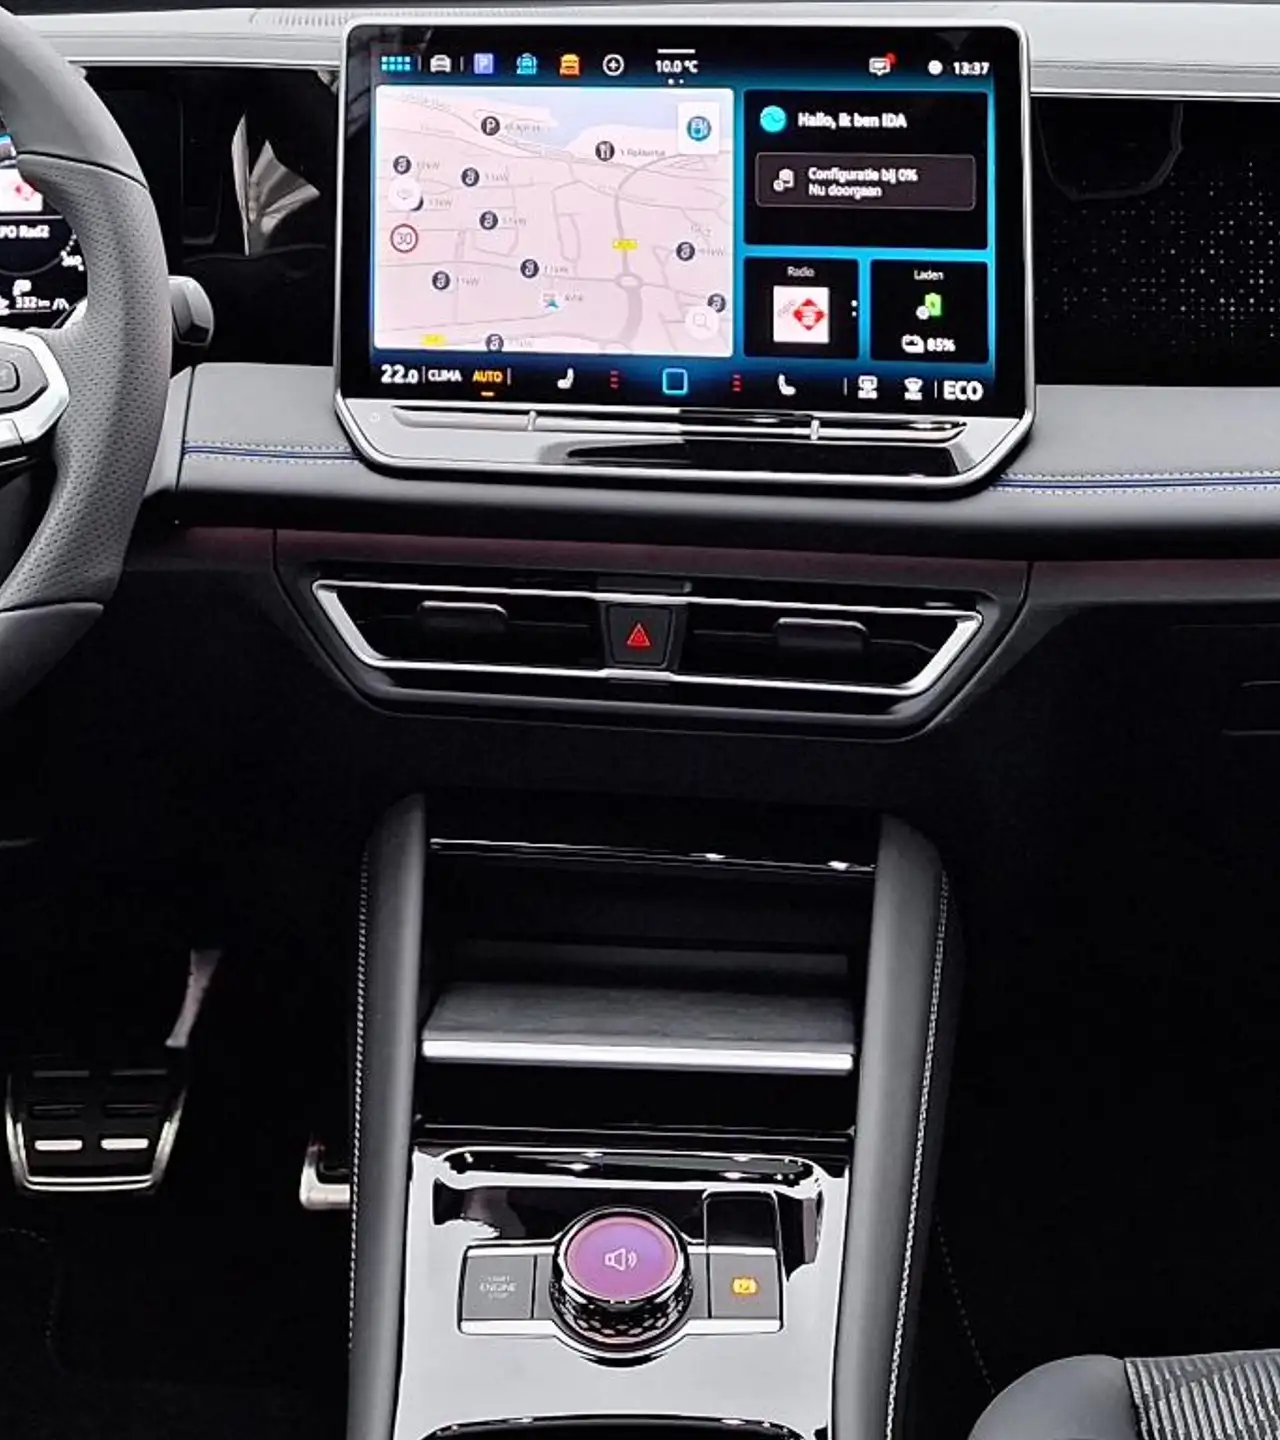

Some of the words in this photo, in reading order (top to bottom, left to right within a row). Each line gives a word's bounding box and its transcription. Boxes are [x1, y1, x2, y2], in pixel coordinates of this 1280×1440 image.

[655, 60, 682, 74] 10.0
[953, 61, 990, 76] 13:37
[797, 112, 837, 130] Hallo,
[852, 112, 880, 129] ben
[881, 112, 908, 129] IDA
[807, 167, 880, 184] Configuratie
[880, 167, 897, 184] bij
[897, 168, 919, 182] 0%
[808, 183, 826, 197] Nu
[827, 183, 883, 200] doorgaan
[396, 231, 413, 245] 30
[787, 266, 816, 278] Radio
[914, 270, 944, 281] Laden
[380, 363, 419, 384] 22.0
[427, 369, 463, 383] CLIMA
[472, 370, 504, 383] AUTO
[943, 380, 984, 401] ECO
